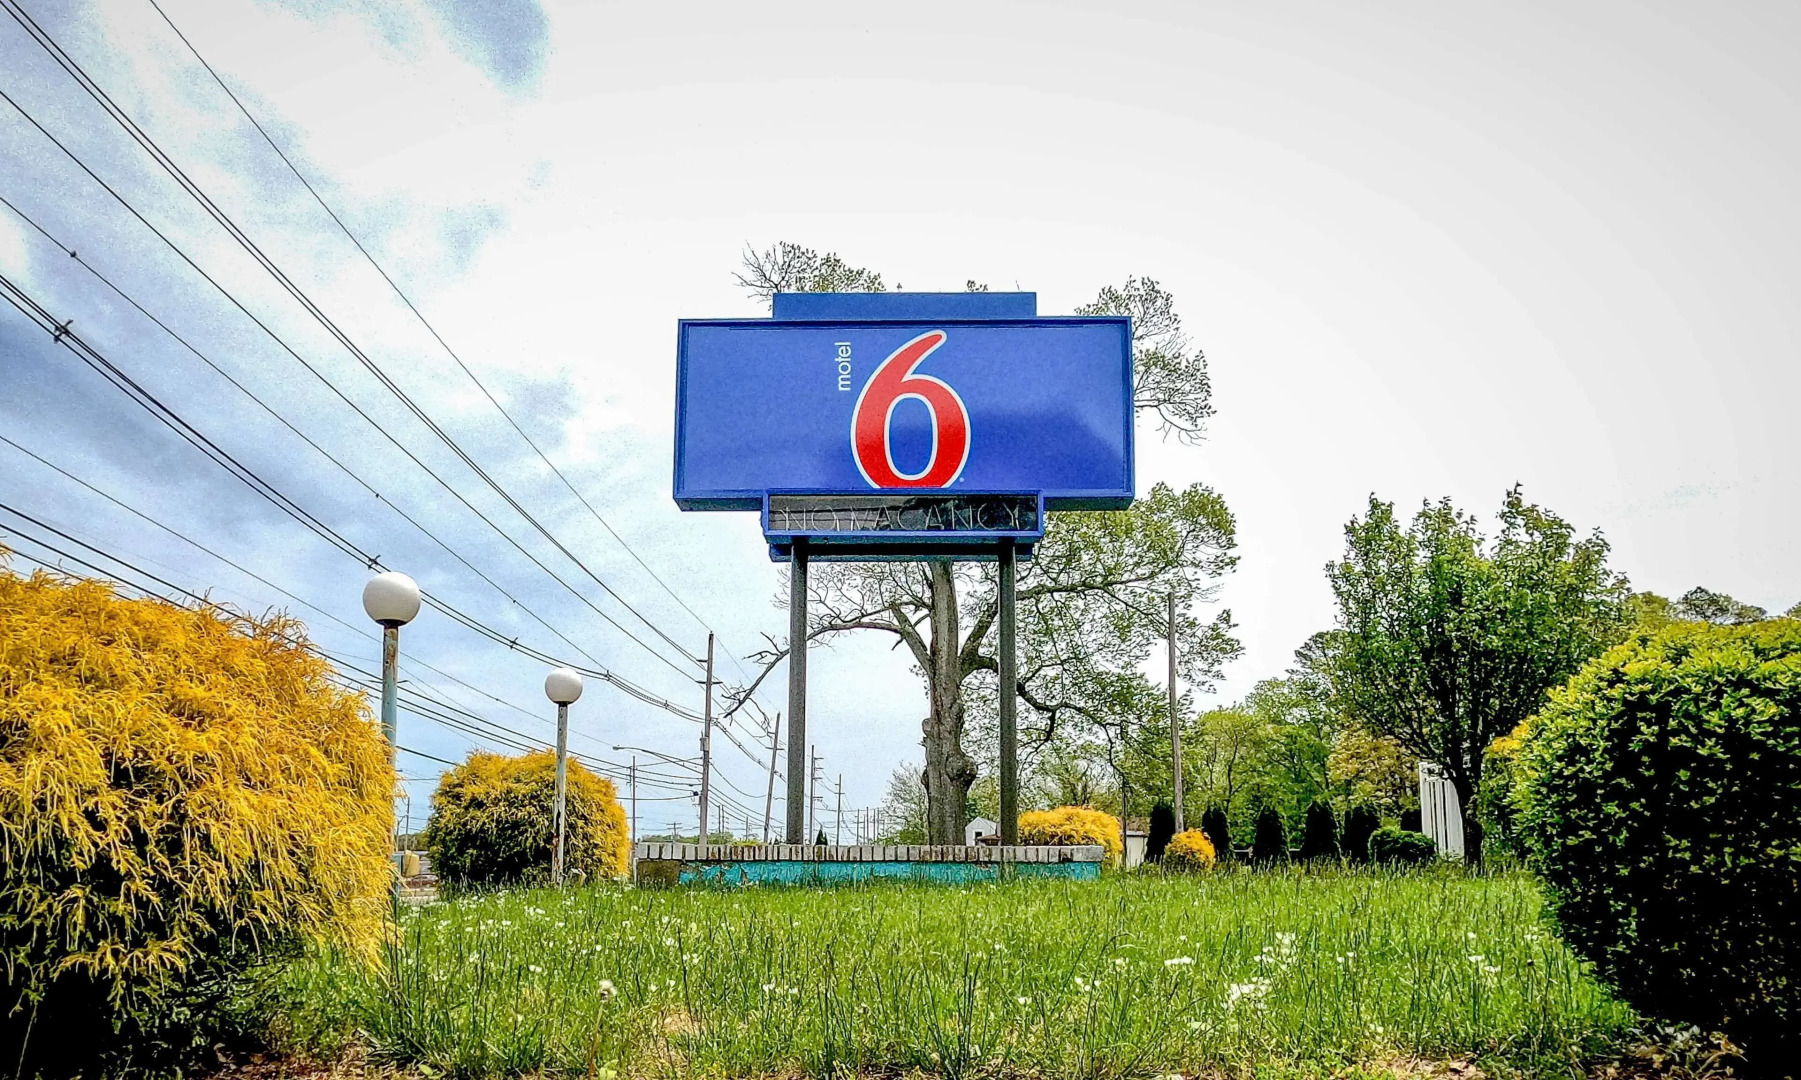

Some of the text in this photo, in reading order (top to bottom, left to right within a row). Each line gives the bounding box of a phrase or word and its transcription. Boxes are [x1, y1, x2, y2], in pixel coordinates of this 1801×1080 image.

[834, 341, 851, 391] motel
[850, 329, 972, 488] 6
[780, 500, 1021, 531] NO VACANCY
